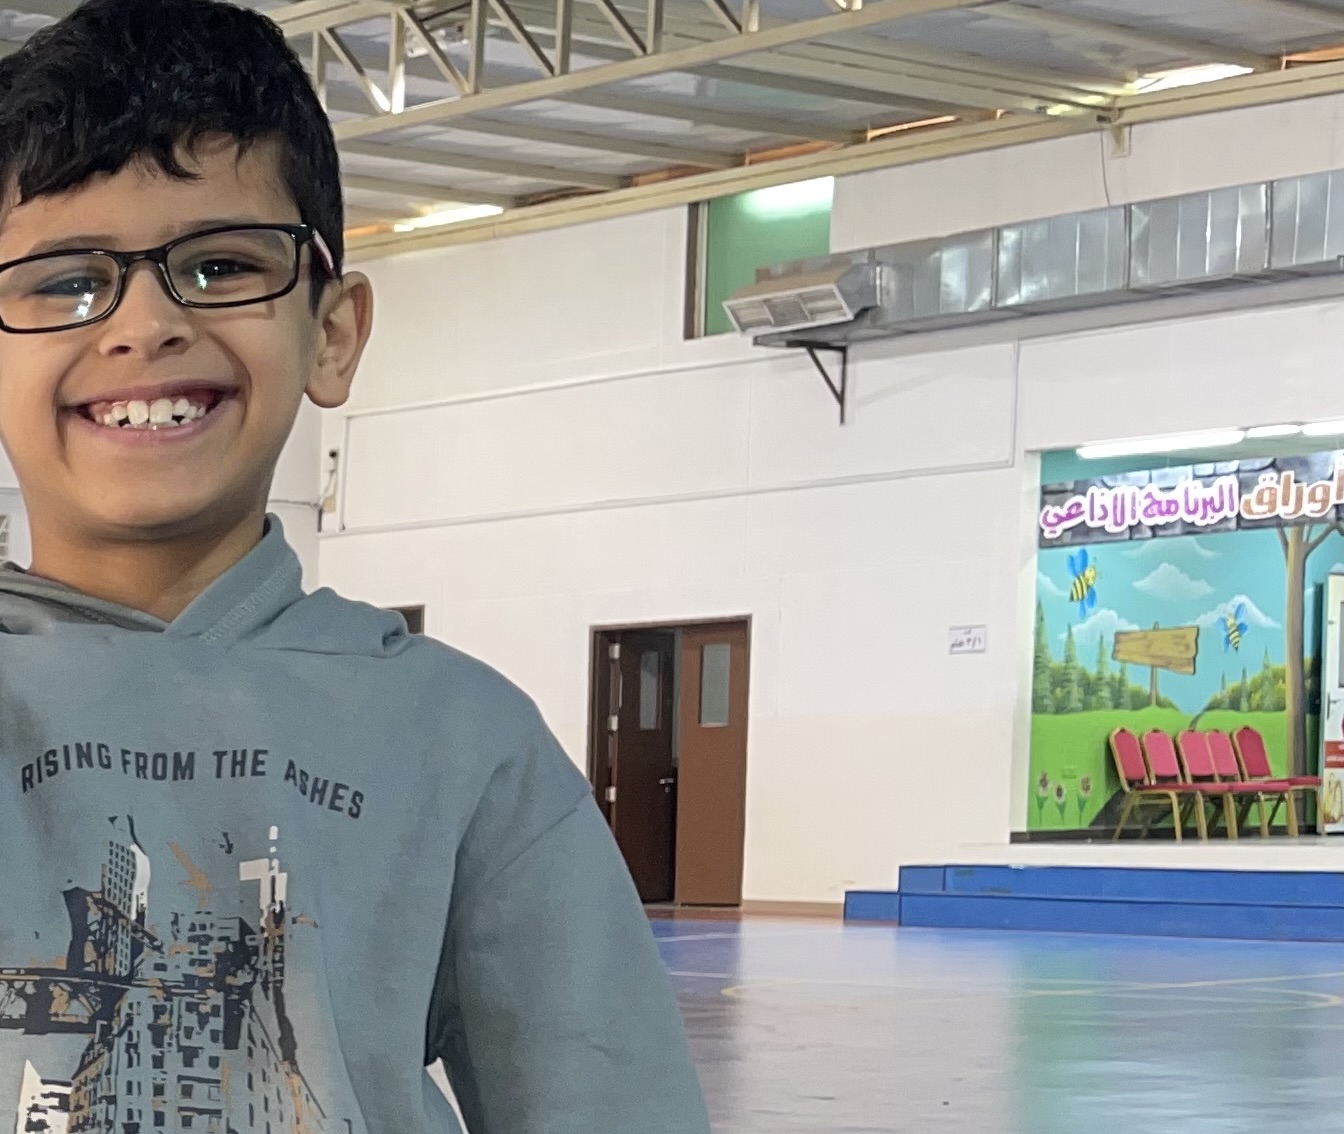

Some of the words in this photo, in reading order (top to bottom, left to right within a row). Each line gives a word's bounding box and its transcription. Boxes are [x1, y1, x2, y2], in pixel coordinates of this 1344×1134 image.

[20, 742, 112, 793] RISING
[120, 748, 196, 781] FROM
[212, 749, 269, 779] THE
[284, 759, 365, 820] ASHES
